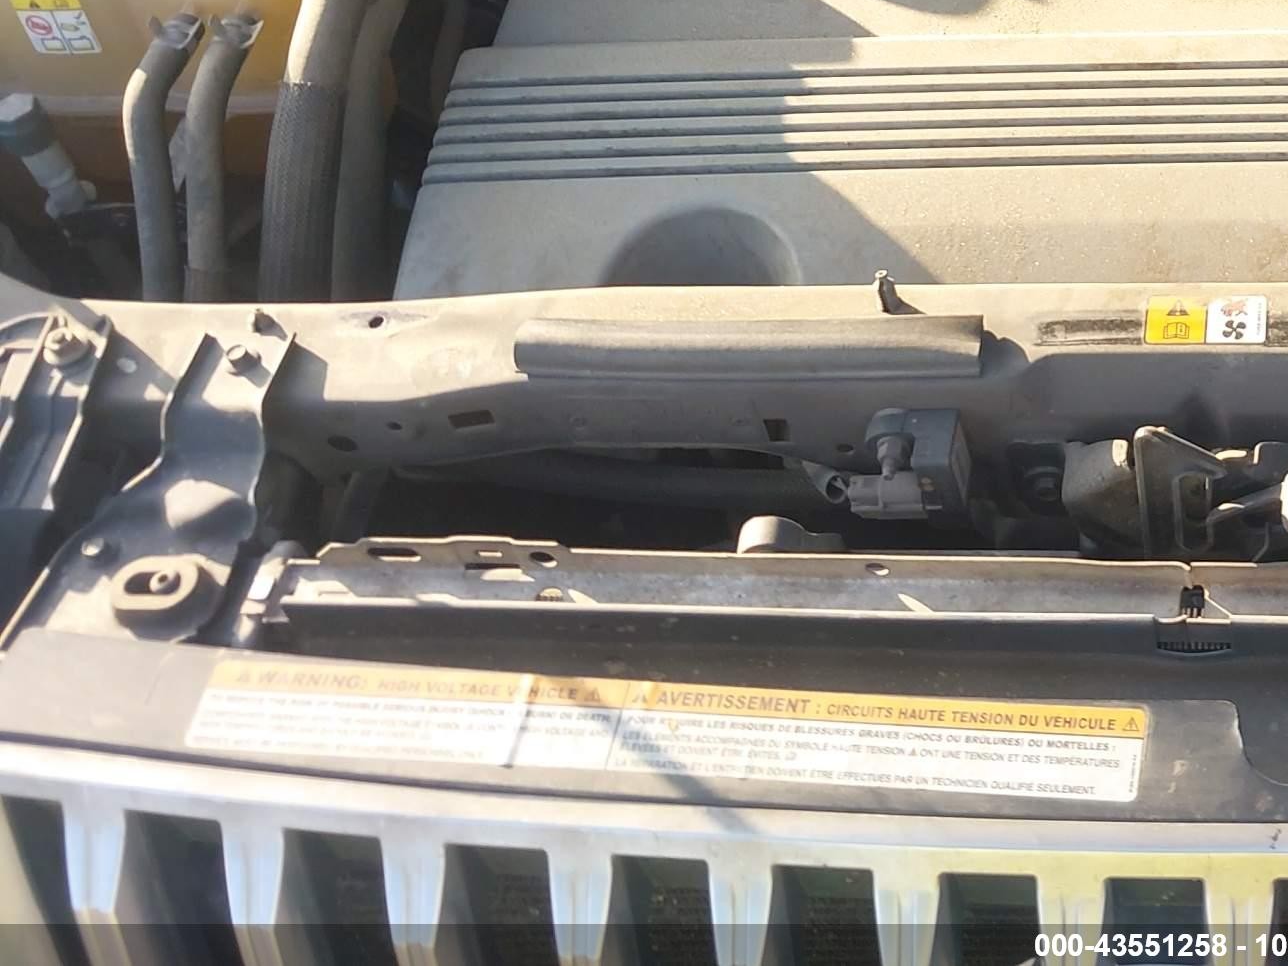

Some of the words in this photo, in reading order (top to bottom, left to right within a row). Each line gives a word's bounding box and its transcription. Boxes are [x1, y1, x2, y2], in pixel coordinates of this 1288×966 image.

[258, 670, 368, 690] WARNING:
[425, 682, 502, 697] VOLTAGE
[507, 686, 578, 701] VHICLE
[656, 690, 811, 715] AVERTISSEMENT
[826, 702, 893, 719] CIRCUITS
[897, 706, 945, 722] HAUTE
[951, 709, 1014, 725] TENSION
[1018, 713, 1039, 727] DU
[707, 719, 726, 729] LES
[729, 720, 775, 732] RISQUES
[779, 723, 791, 733] DE
[794, 724, 855, 737] BLESSURES
[858, 728, 899, 741] GRAVES
[946, 733, 961, 744] OU
[1028, 738, 1043, 749] OU
[1046, 738, 1109, 752] MORTELLES
[865, 744, 906, 756] TENSION
[919, 747, 938, 758] ONT
[942, 749, 961, 760] UNE
[964, 750, 1004, 762] TENSION
[1007, 752, 1019, 763] ET
[1022, 753, 1041, 764] DES
[894, 773, 913, 785] PAR
[915, 774, 928, 786] UN
[931, 775, 988, 789] TECHNICIEN
